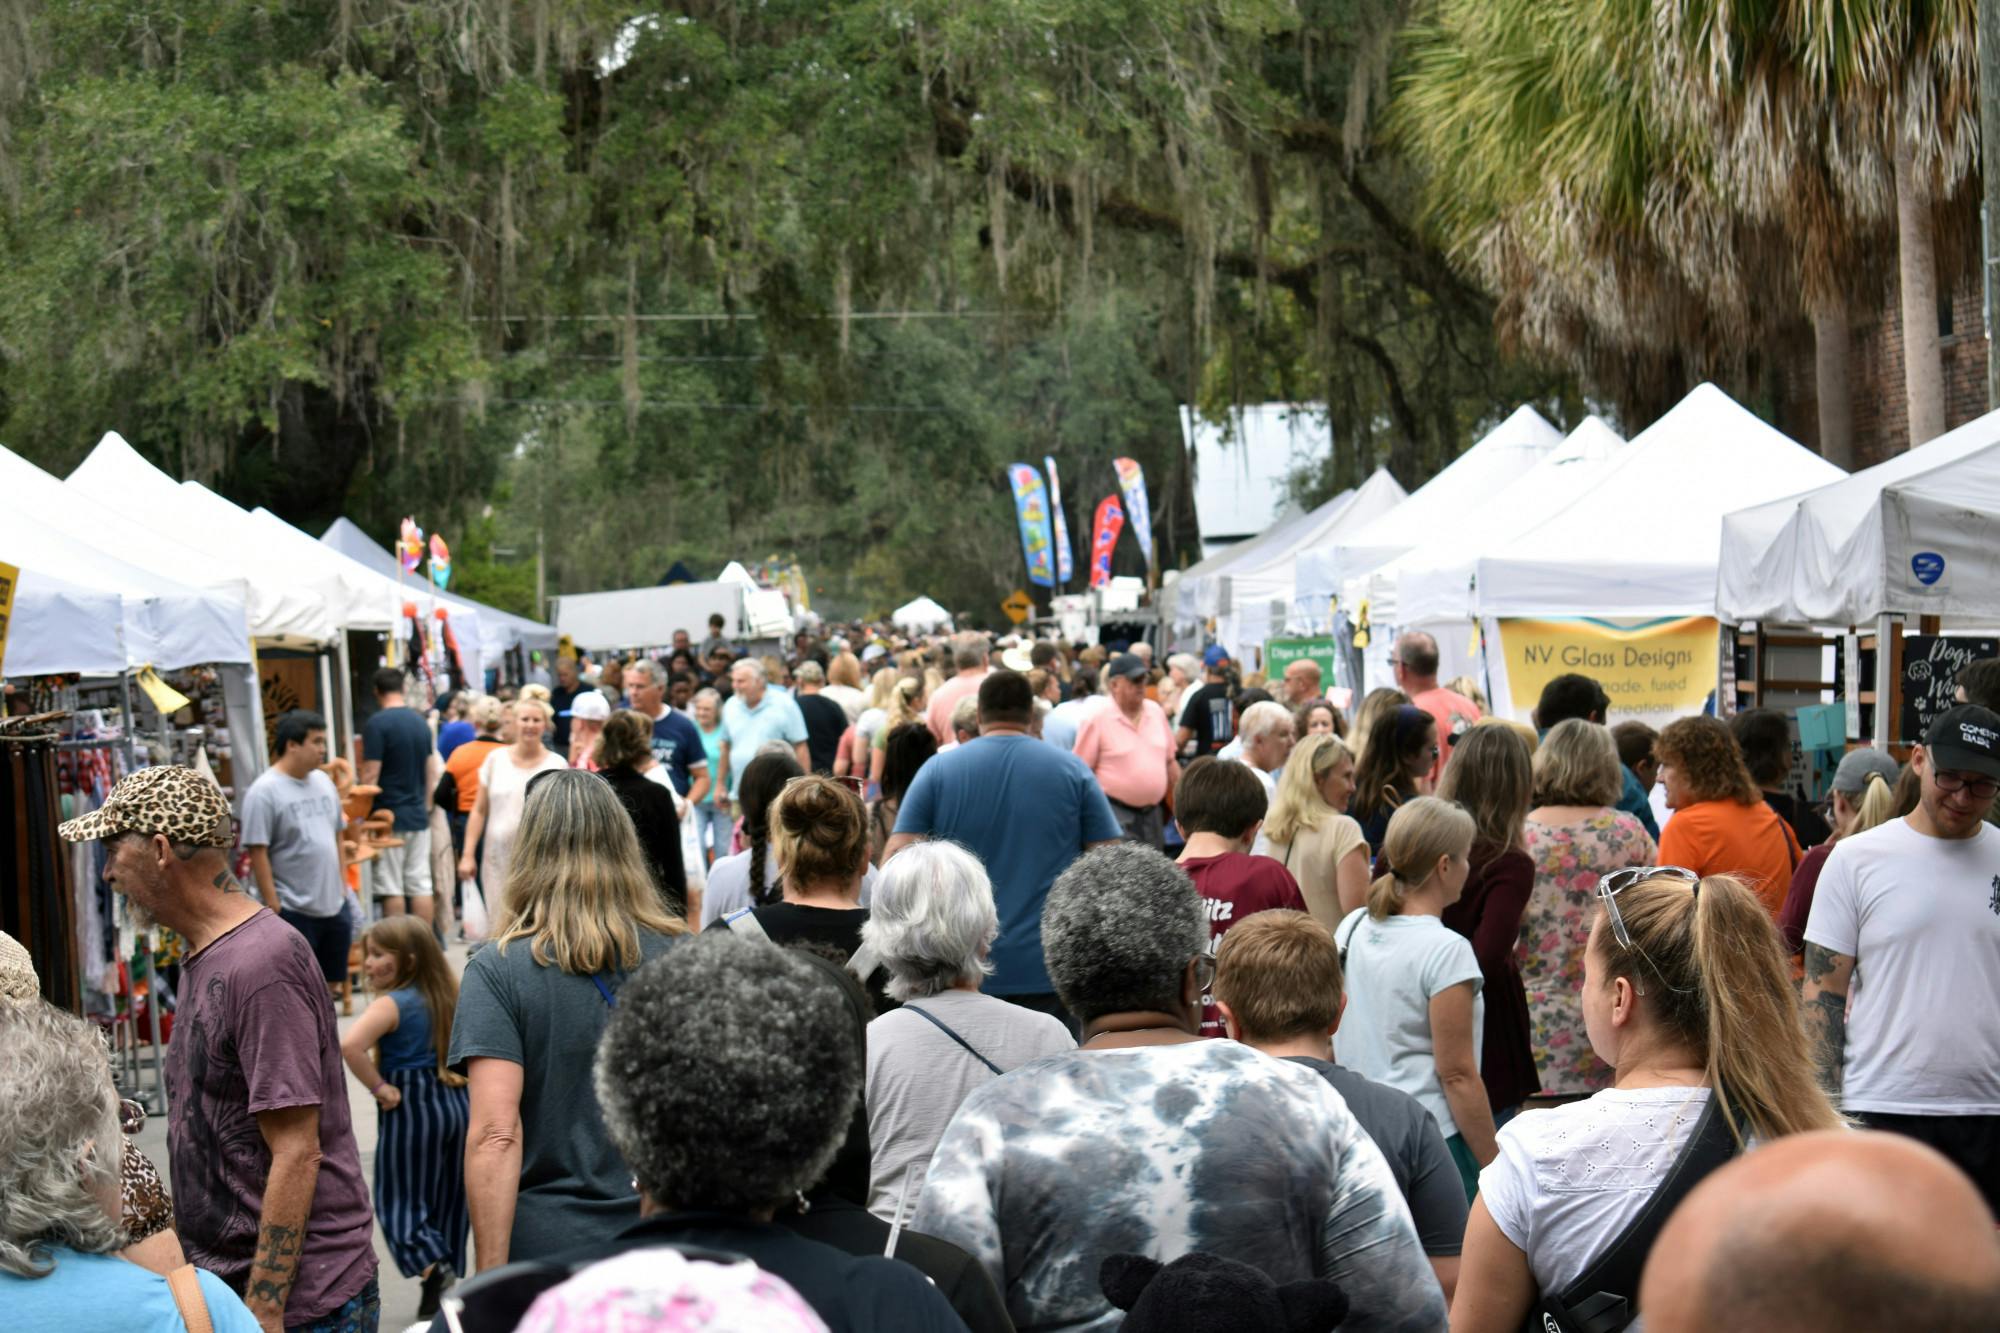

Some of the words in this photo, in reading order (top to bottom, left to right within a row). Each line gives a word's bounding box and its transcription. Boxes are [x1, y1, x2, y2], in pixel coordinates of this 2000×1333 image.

[1525, 644, 1554, 664] NV
[1561, 645, 1615, 667] Glass
[1624, 646, 1693, 670] Designs
[1928, 638, 1976, 671] Dogs
[1651, 676, 1687, 692] fused
